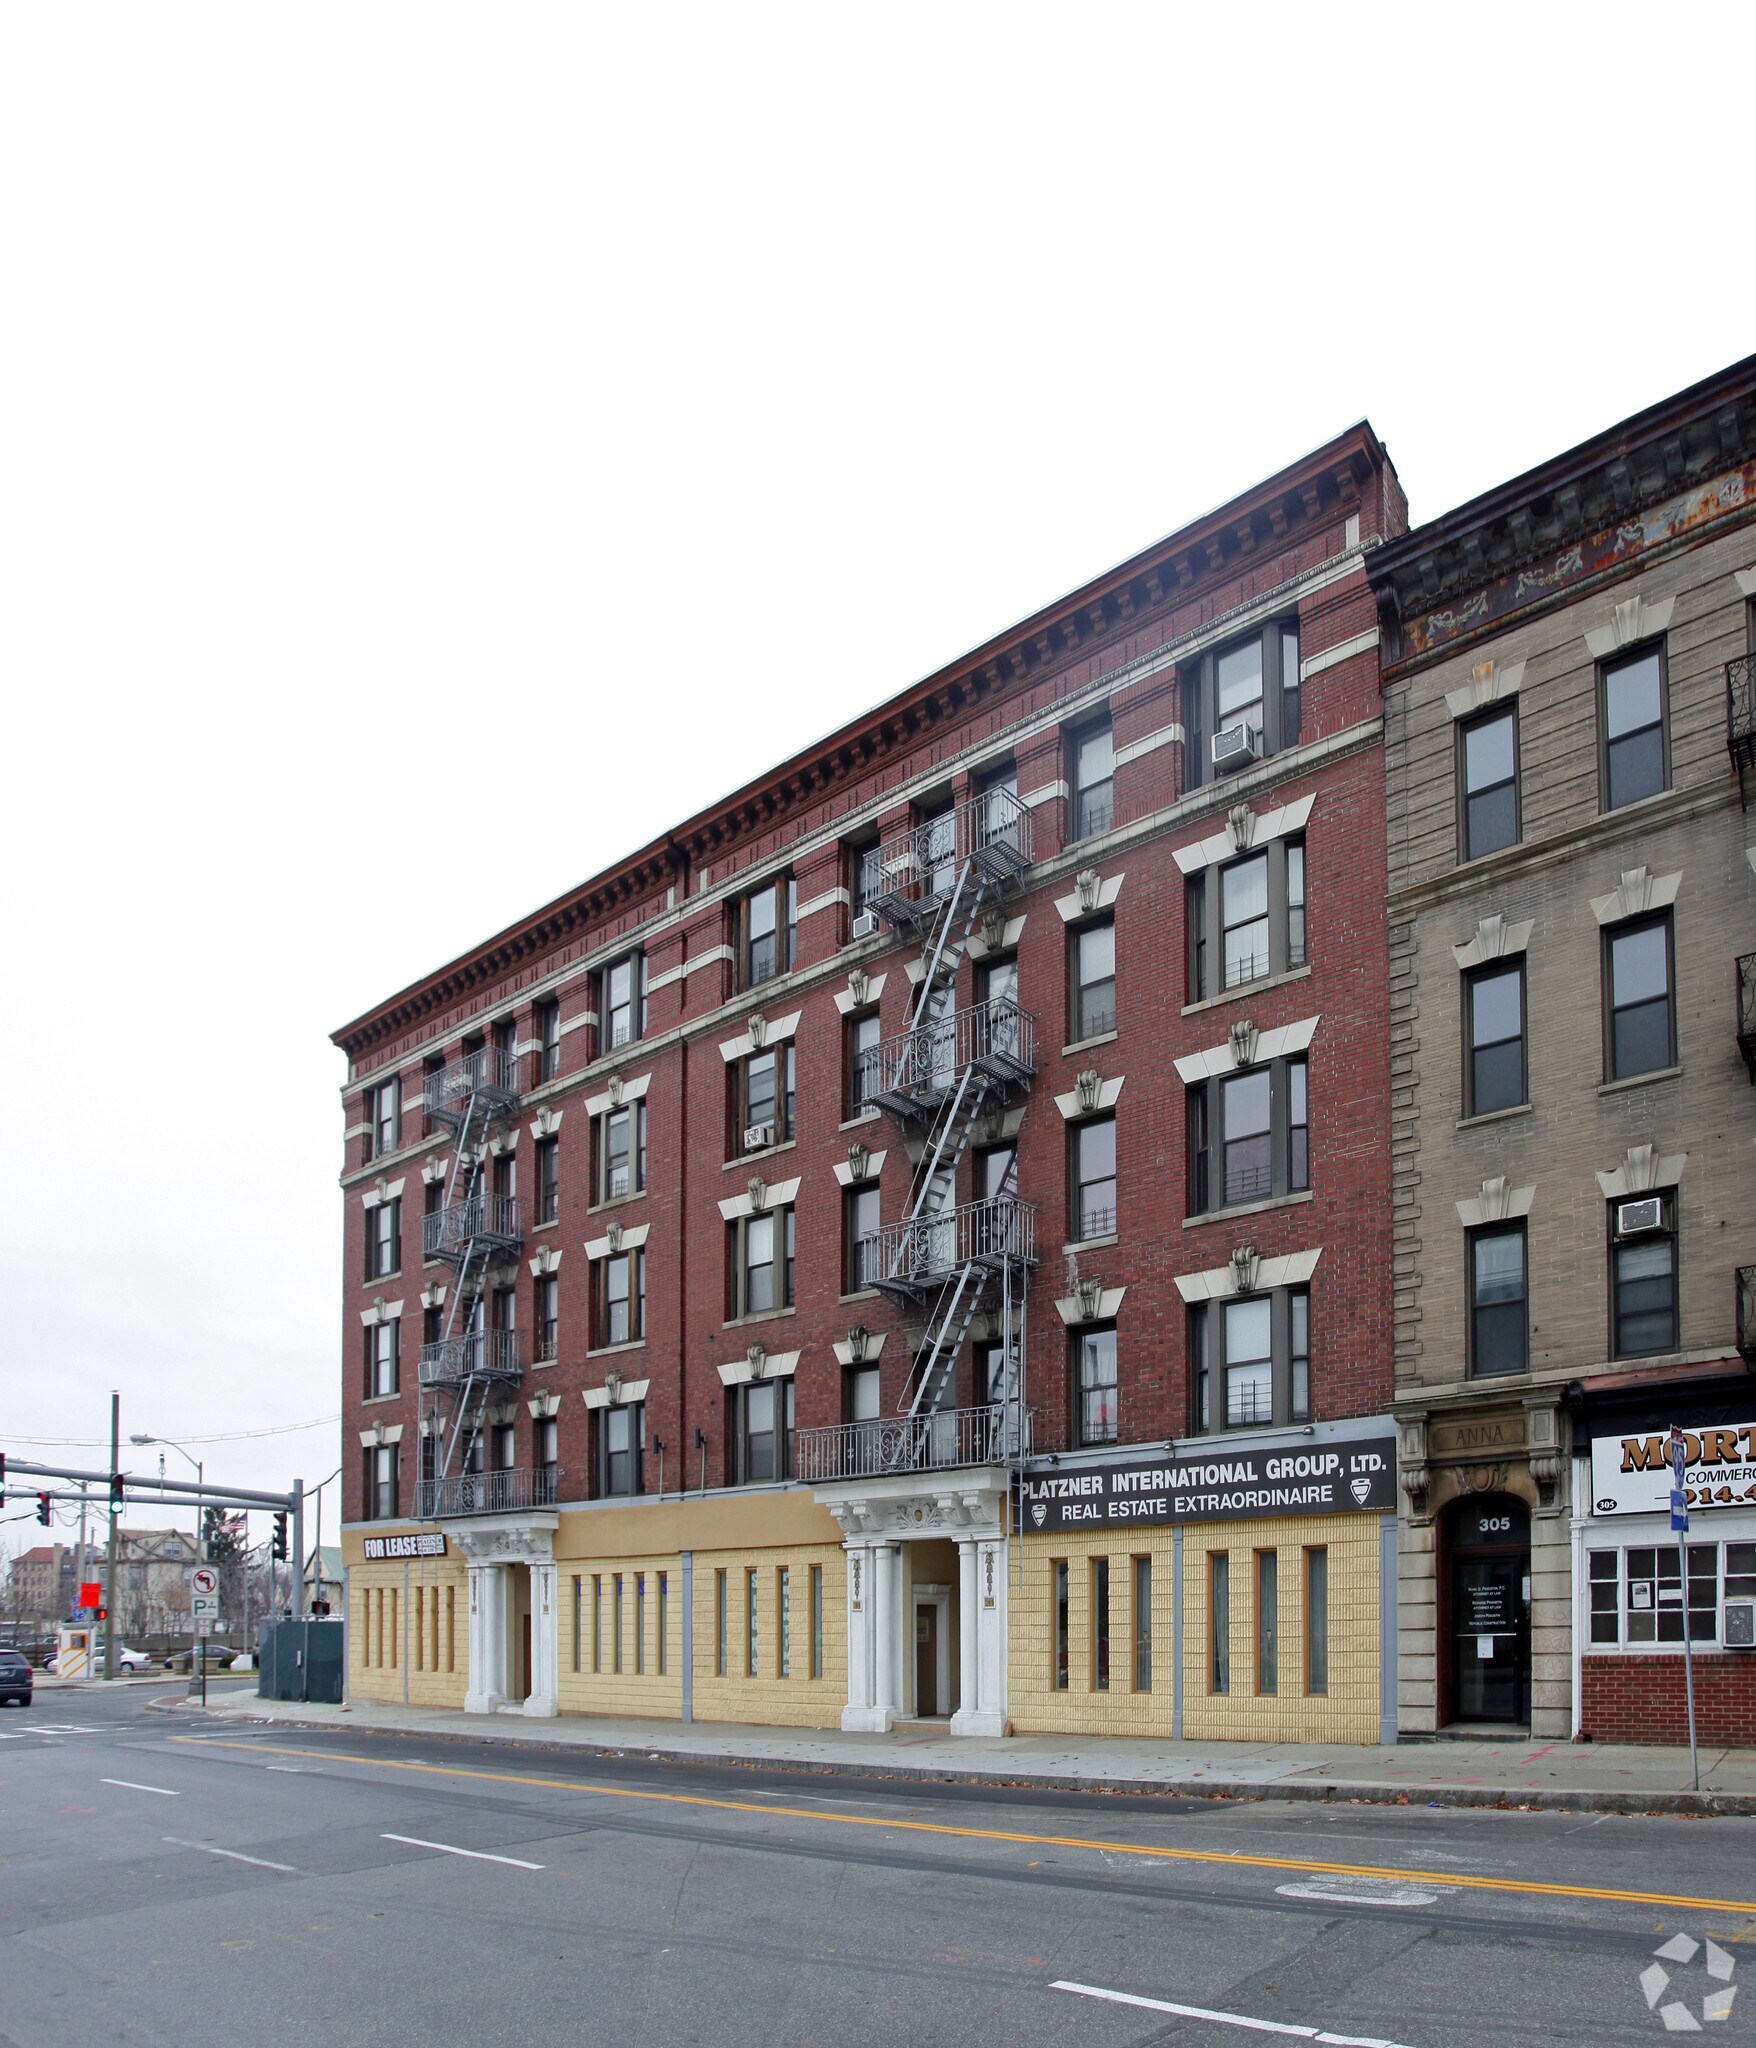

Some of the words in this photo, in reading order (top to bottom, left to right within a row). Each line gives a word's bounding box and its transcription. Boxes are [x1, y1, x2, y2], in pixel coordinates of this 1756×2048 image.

[1456, 1425, 1504, 1446] ANNA
[1021, 1474, 1103, 1501] PLATZNER
[1112, 1461, 1258, 1493] INTERNATIONAL
[1265, 1453, 1344, 1480] GROUP,
[1350, 1453, 1387, 1473] LTD.
[1061, 1503, 1102, 1521] REAL
[1108, 1498, 1167, 1517] ESTATE
[1174, 1484, 1333, 1513] EXTRAORDINAIRE
[1599, 1501, 1615, 1509] 305
[1479, 1516, 1511, 1532] 305
[364, 1539, 384, 1558] FOR
[385, 1536, 418, 1557] LEASE
